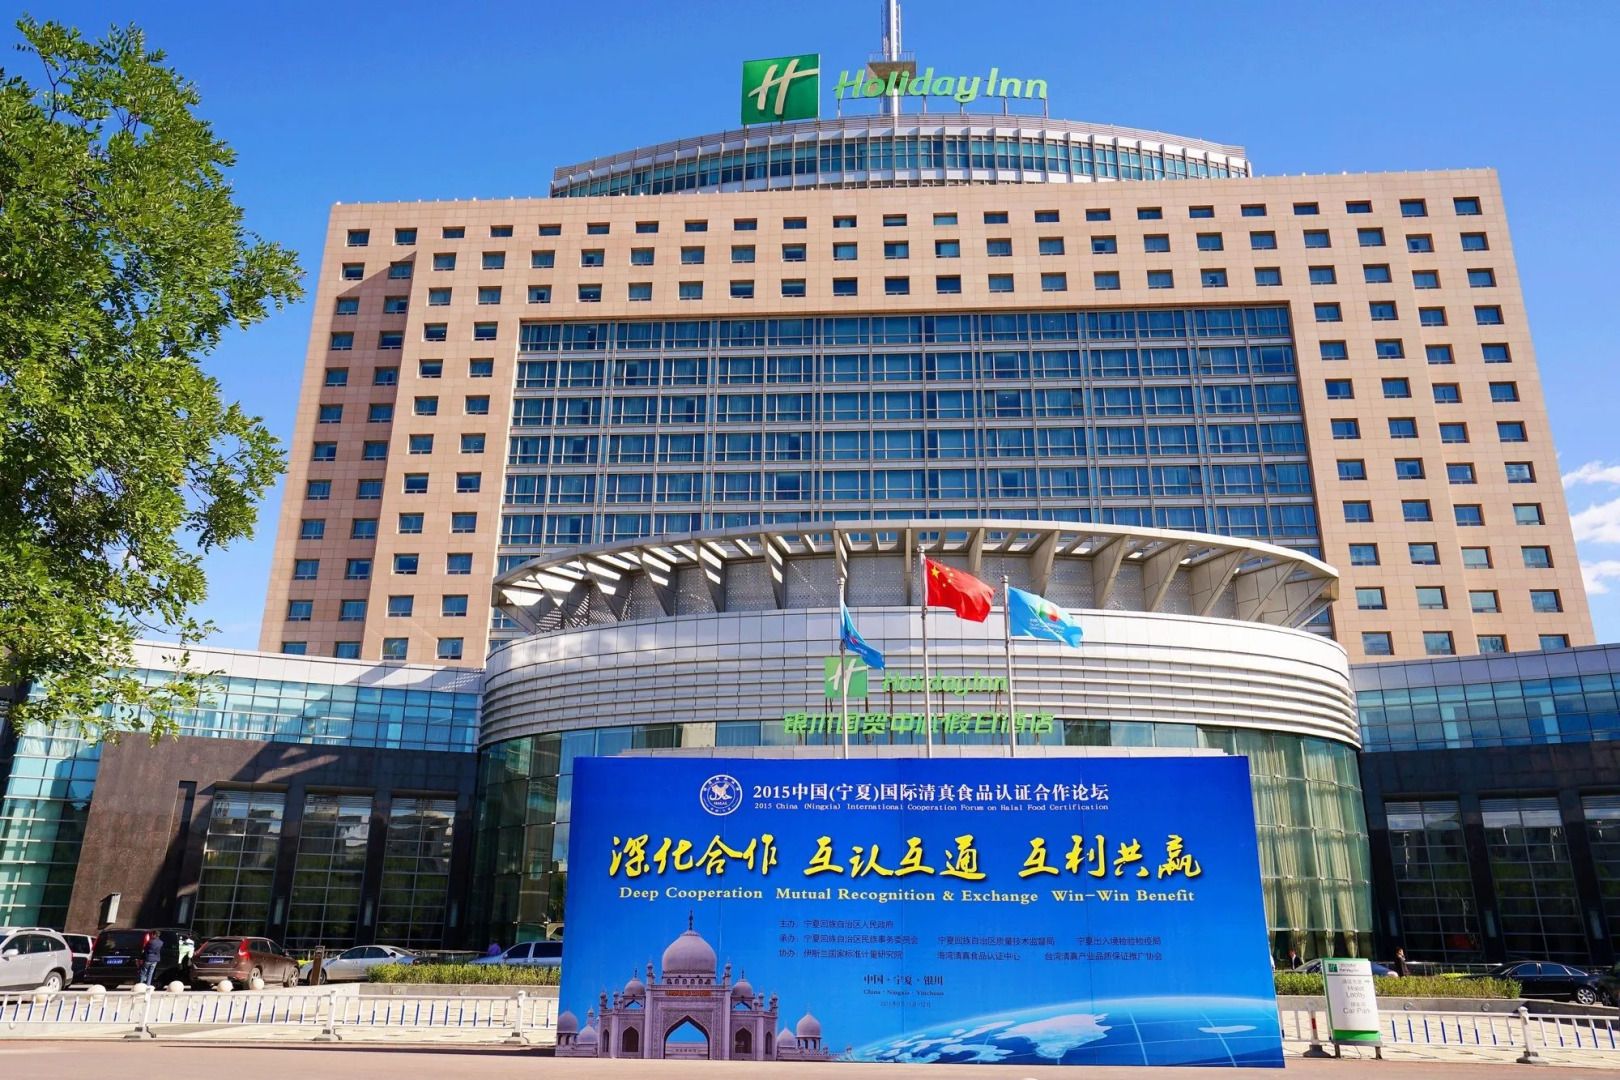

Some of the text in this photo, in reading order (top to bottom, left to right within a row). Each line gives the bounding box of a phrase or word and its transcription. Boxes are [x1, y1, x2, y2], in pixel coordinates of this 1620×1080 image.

[832, 67, 1047, 103] Holiday Inn
[804, 803, 841, 811] (Ningxia)
[847, 803, 904, 811] International
[907, 803, 957, 812] Cooperation
[1049, 803, 1109, 811] Certification
[609, 834, 1201, 880] 深化合作 互认互通 互利共赢
[619, 887, 659, 901] Deep
[666, 887, 763, 901] Cooperation
[776, 887, 831, 900] Mutual
[838, 888, 935, 903] Recognition
[942, 890, 954, 901] &
[961, 889, 1038, 905] Exchange
[1136, 889, 1195, 902] Benefit
